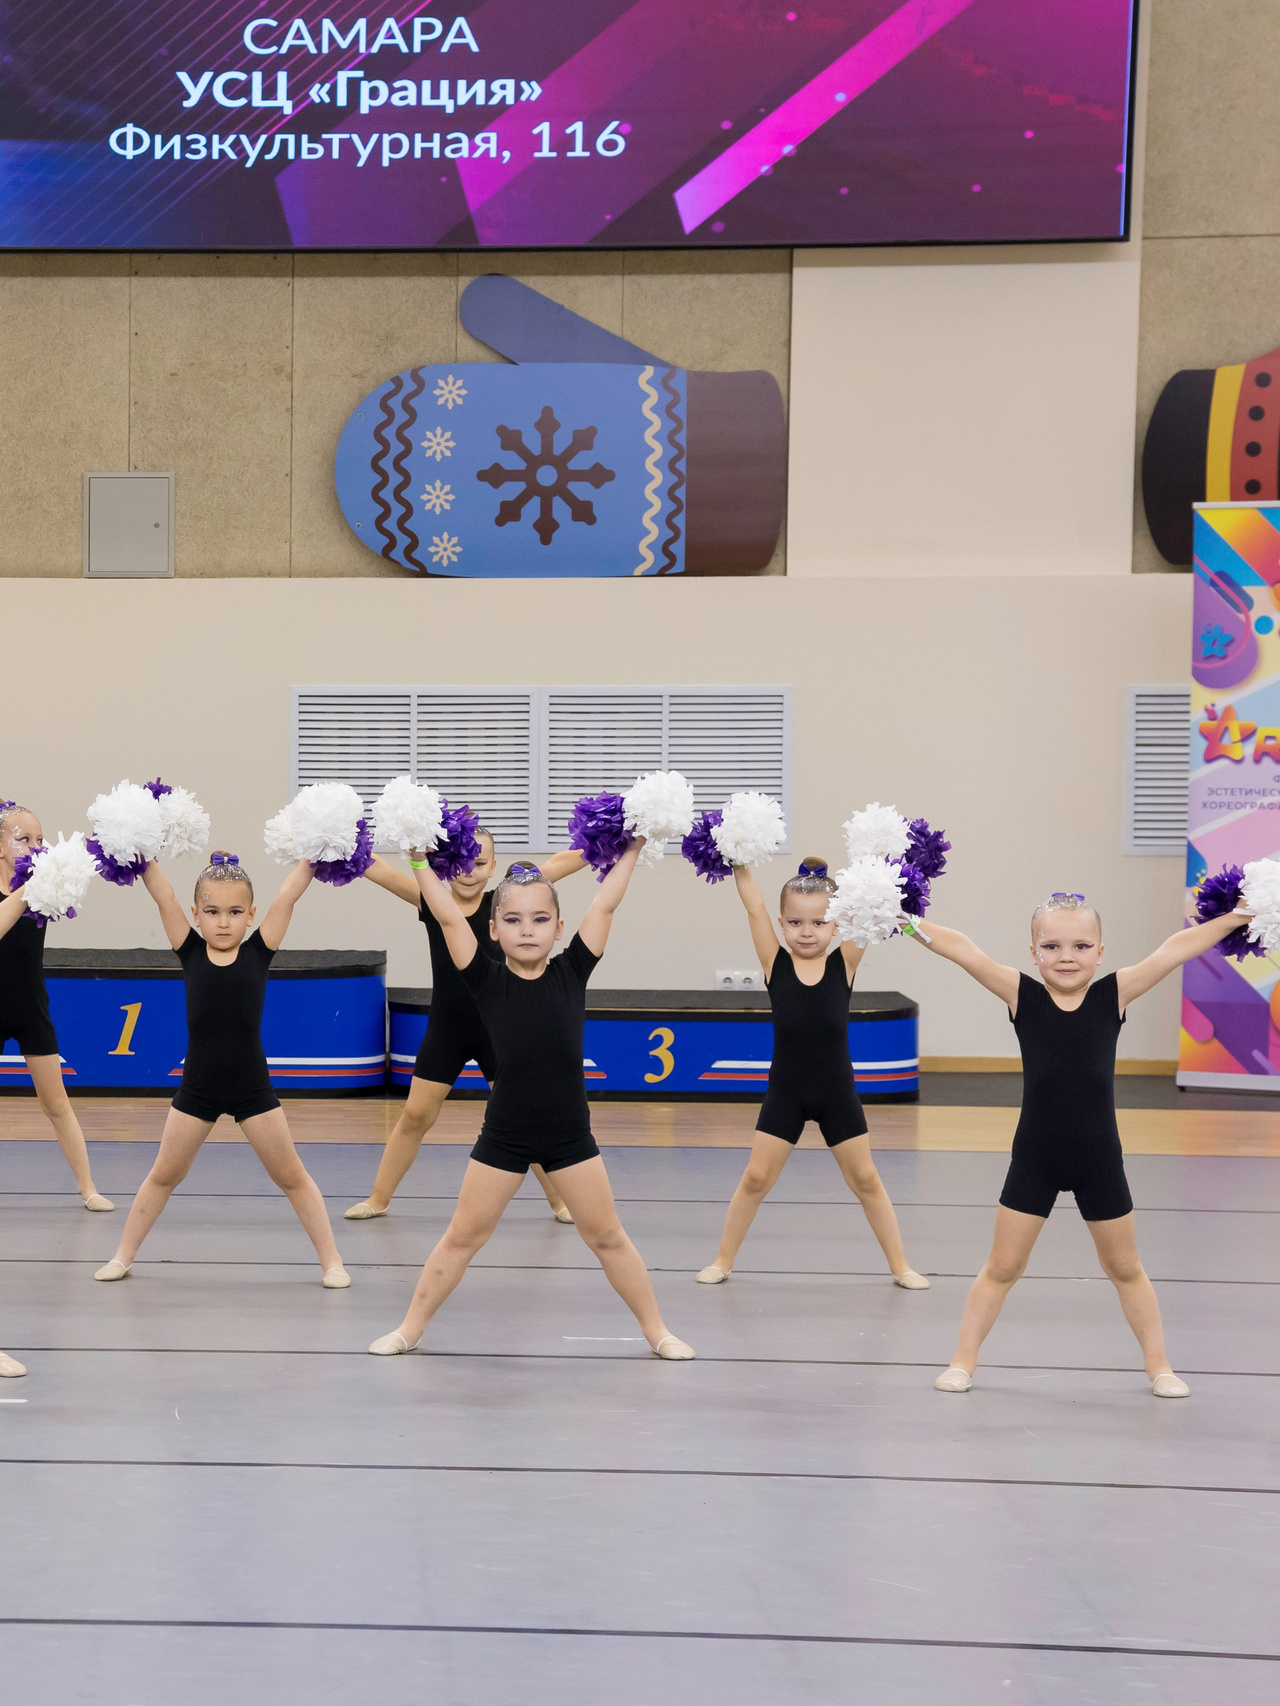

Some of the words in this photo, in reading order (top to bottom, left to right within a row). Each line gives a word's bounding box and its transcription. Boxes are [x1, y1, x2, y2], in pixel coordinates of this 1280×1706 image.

[242, 16, 480, 55] САМАРА
[175, 70, 294, 115] УСЦ
[308, 69, 543, 115] «Грация»
[108, 122, 512, 168] Физкультурная,
[531, 120, 628, 158] 116
[1201, 801, 1280, 811] ХОРЕОГРАФ
[1207, 787, 1280, 797] ЭСТЕТИЧЕС
[108, 1002, 142, 1055] 1
[644, 1027, 675, 1083] 3
